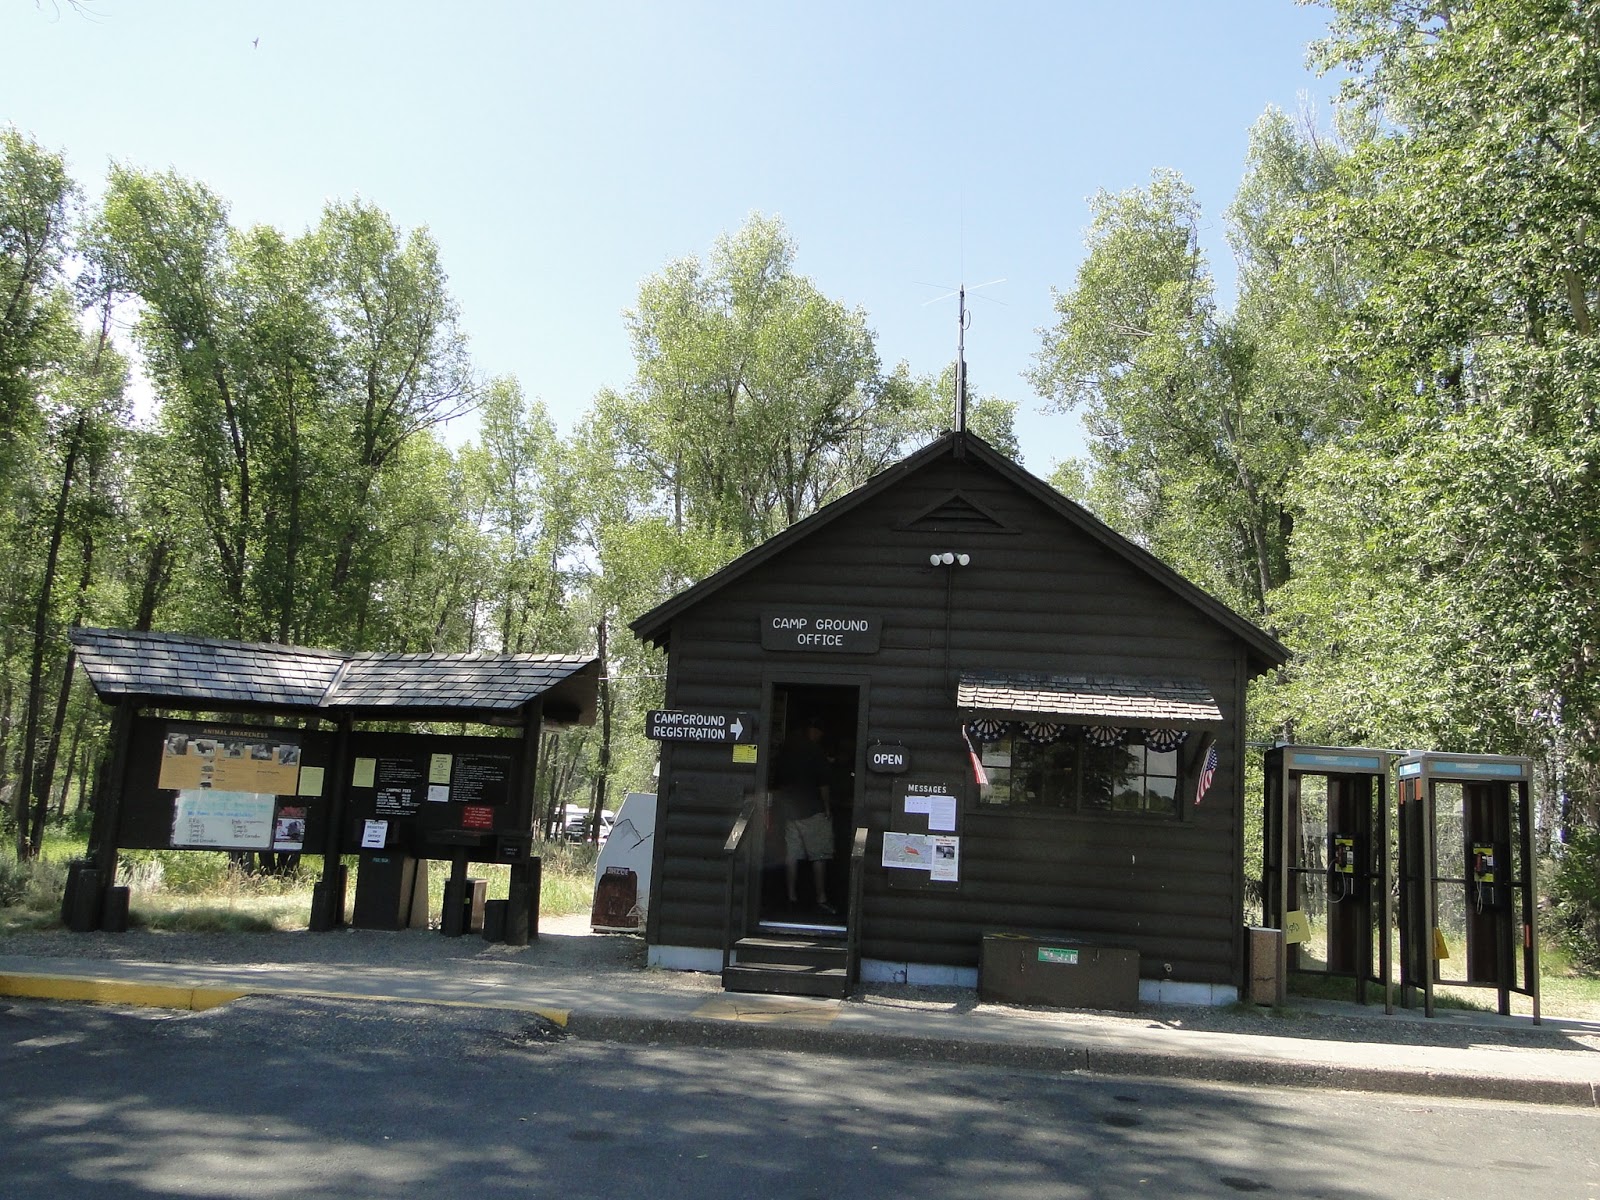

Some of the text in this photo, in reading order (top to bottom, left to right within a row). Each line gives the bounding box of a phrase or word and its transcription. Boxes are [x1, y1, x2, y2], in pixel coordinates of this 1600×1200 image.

[772, 617, 869, 632] CAMP GROUND
[797, 633, 844, 646] OFFICE
[654, 713, 726, 727] CAMPGROUND
[203, 728, 269, 739] ANIMAL AWARENESS
[653, 726, 726, 740] REGISTRATION
[873, 753, 903, 765] OPEN
[908, 784, 947, 794] MESSAGES
